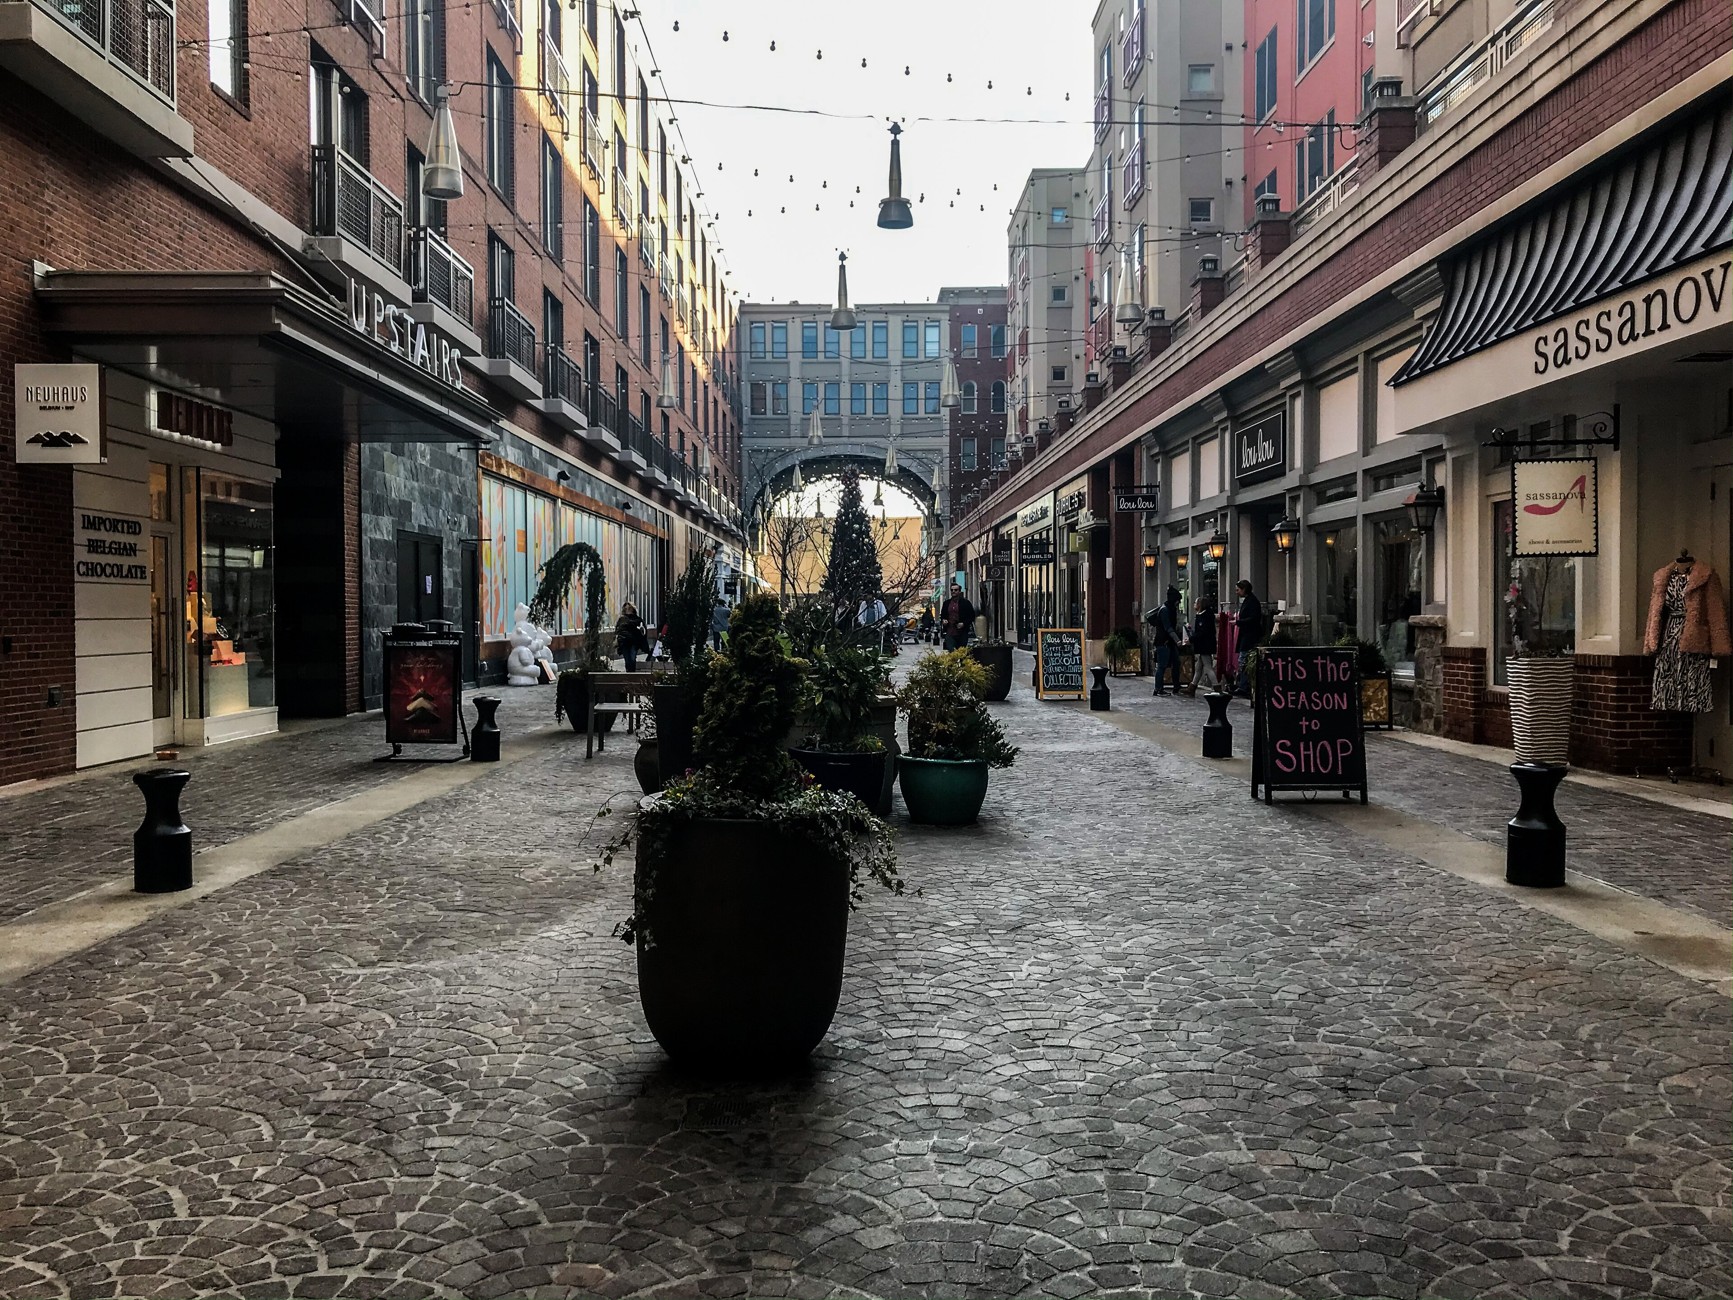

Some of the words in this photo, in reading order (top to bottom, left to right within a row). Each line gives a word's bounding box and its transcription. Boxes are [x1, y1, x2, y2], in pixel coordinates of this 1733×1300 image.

[346, 277, 462, 390] UPSTAIRS
[26, 386, 88, 403] NEUHAUS
[1241, 435, 1258, 469] lou
[1257, 428, 1275, 463] lou
[1119, 497, 1137, 509] lou
[1137, 497, 1155, 509] lou
[1525, 491, 1587, 501] sassanova
[81, 514, 142, 535] IMPORTED
[86, 538, 138, 557] BELGIAN
[76, 560, 147, 580] CHOCOLATE
[1046, 634, 1060, 643] lou
[1062, 634, 1077, 643] lou
[1063, 656, 1082, 666] OUT
[1267, 656, 1307, 681] 'tis
[1313, 656, 1351, 682] the
[1272, 685, 1347, 710] SEASON
[1299, 716, 1320, 735] to
[1275, 739, 1353, 774] SHOP
